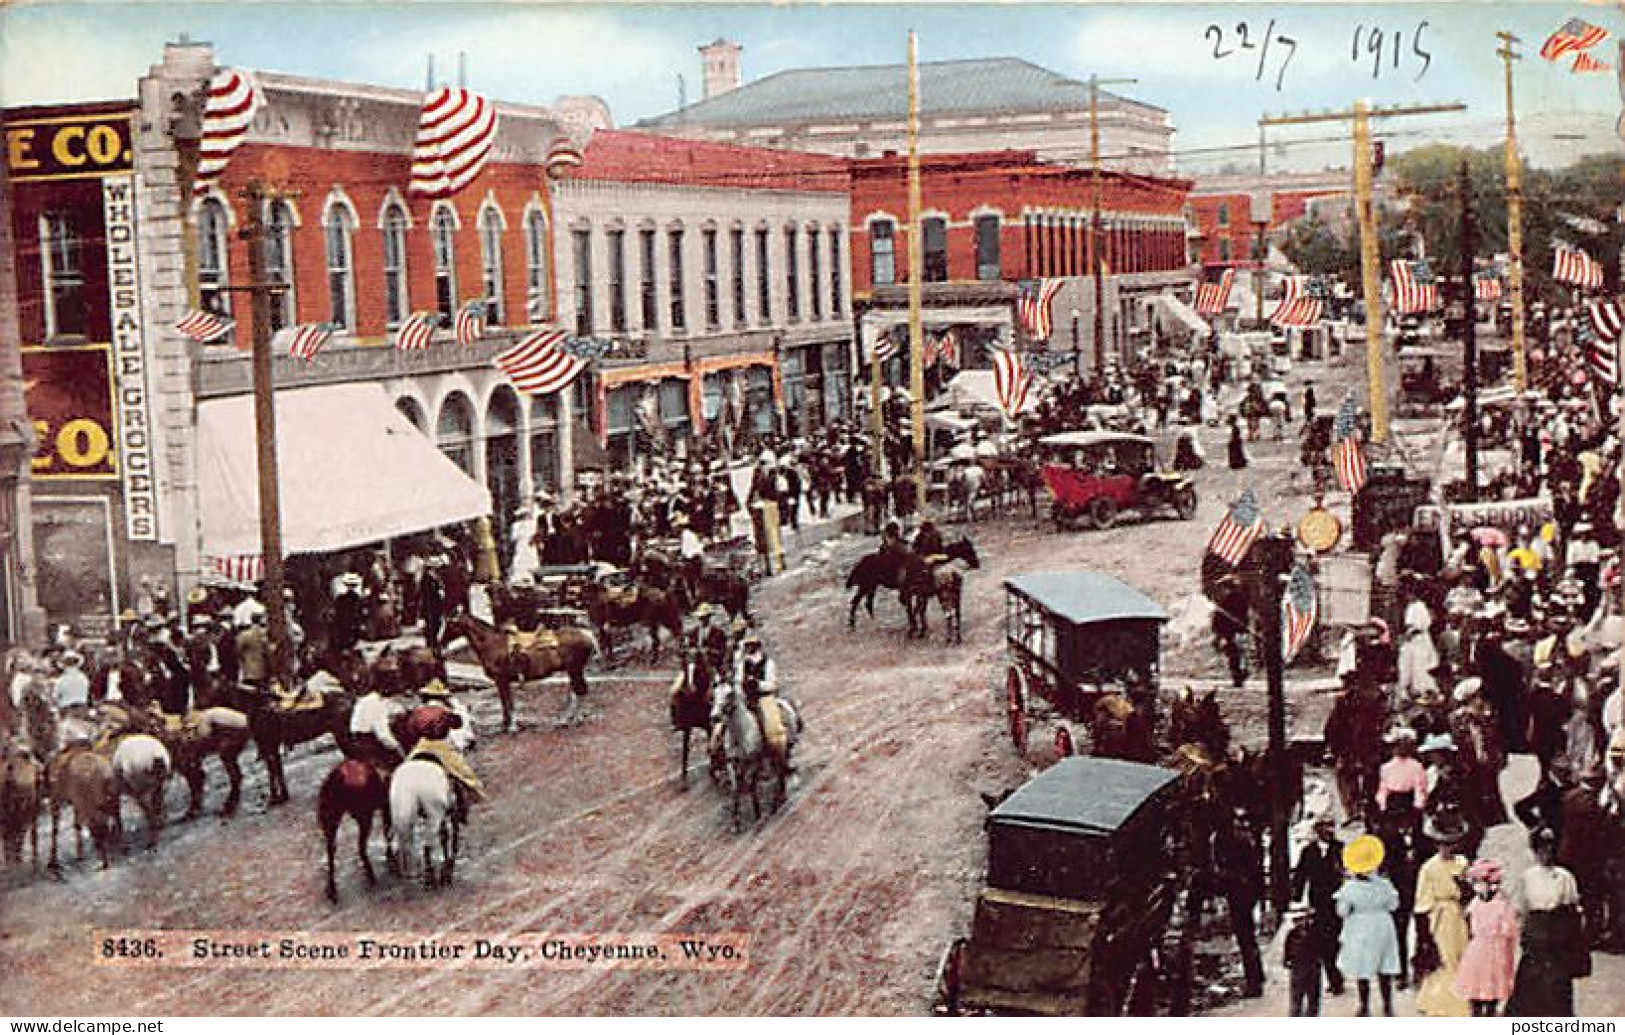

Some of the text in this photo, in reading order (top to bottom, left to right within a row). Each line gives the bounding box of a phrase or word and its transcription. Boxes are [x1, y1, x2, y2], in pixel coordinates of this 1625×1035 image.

[51, 125, 133, 166] CO.
[105, 184, 150, 536] WHOLESALE GROCERS
